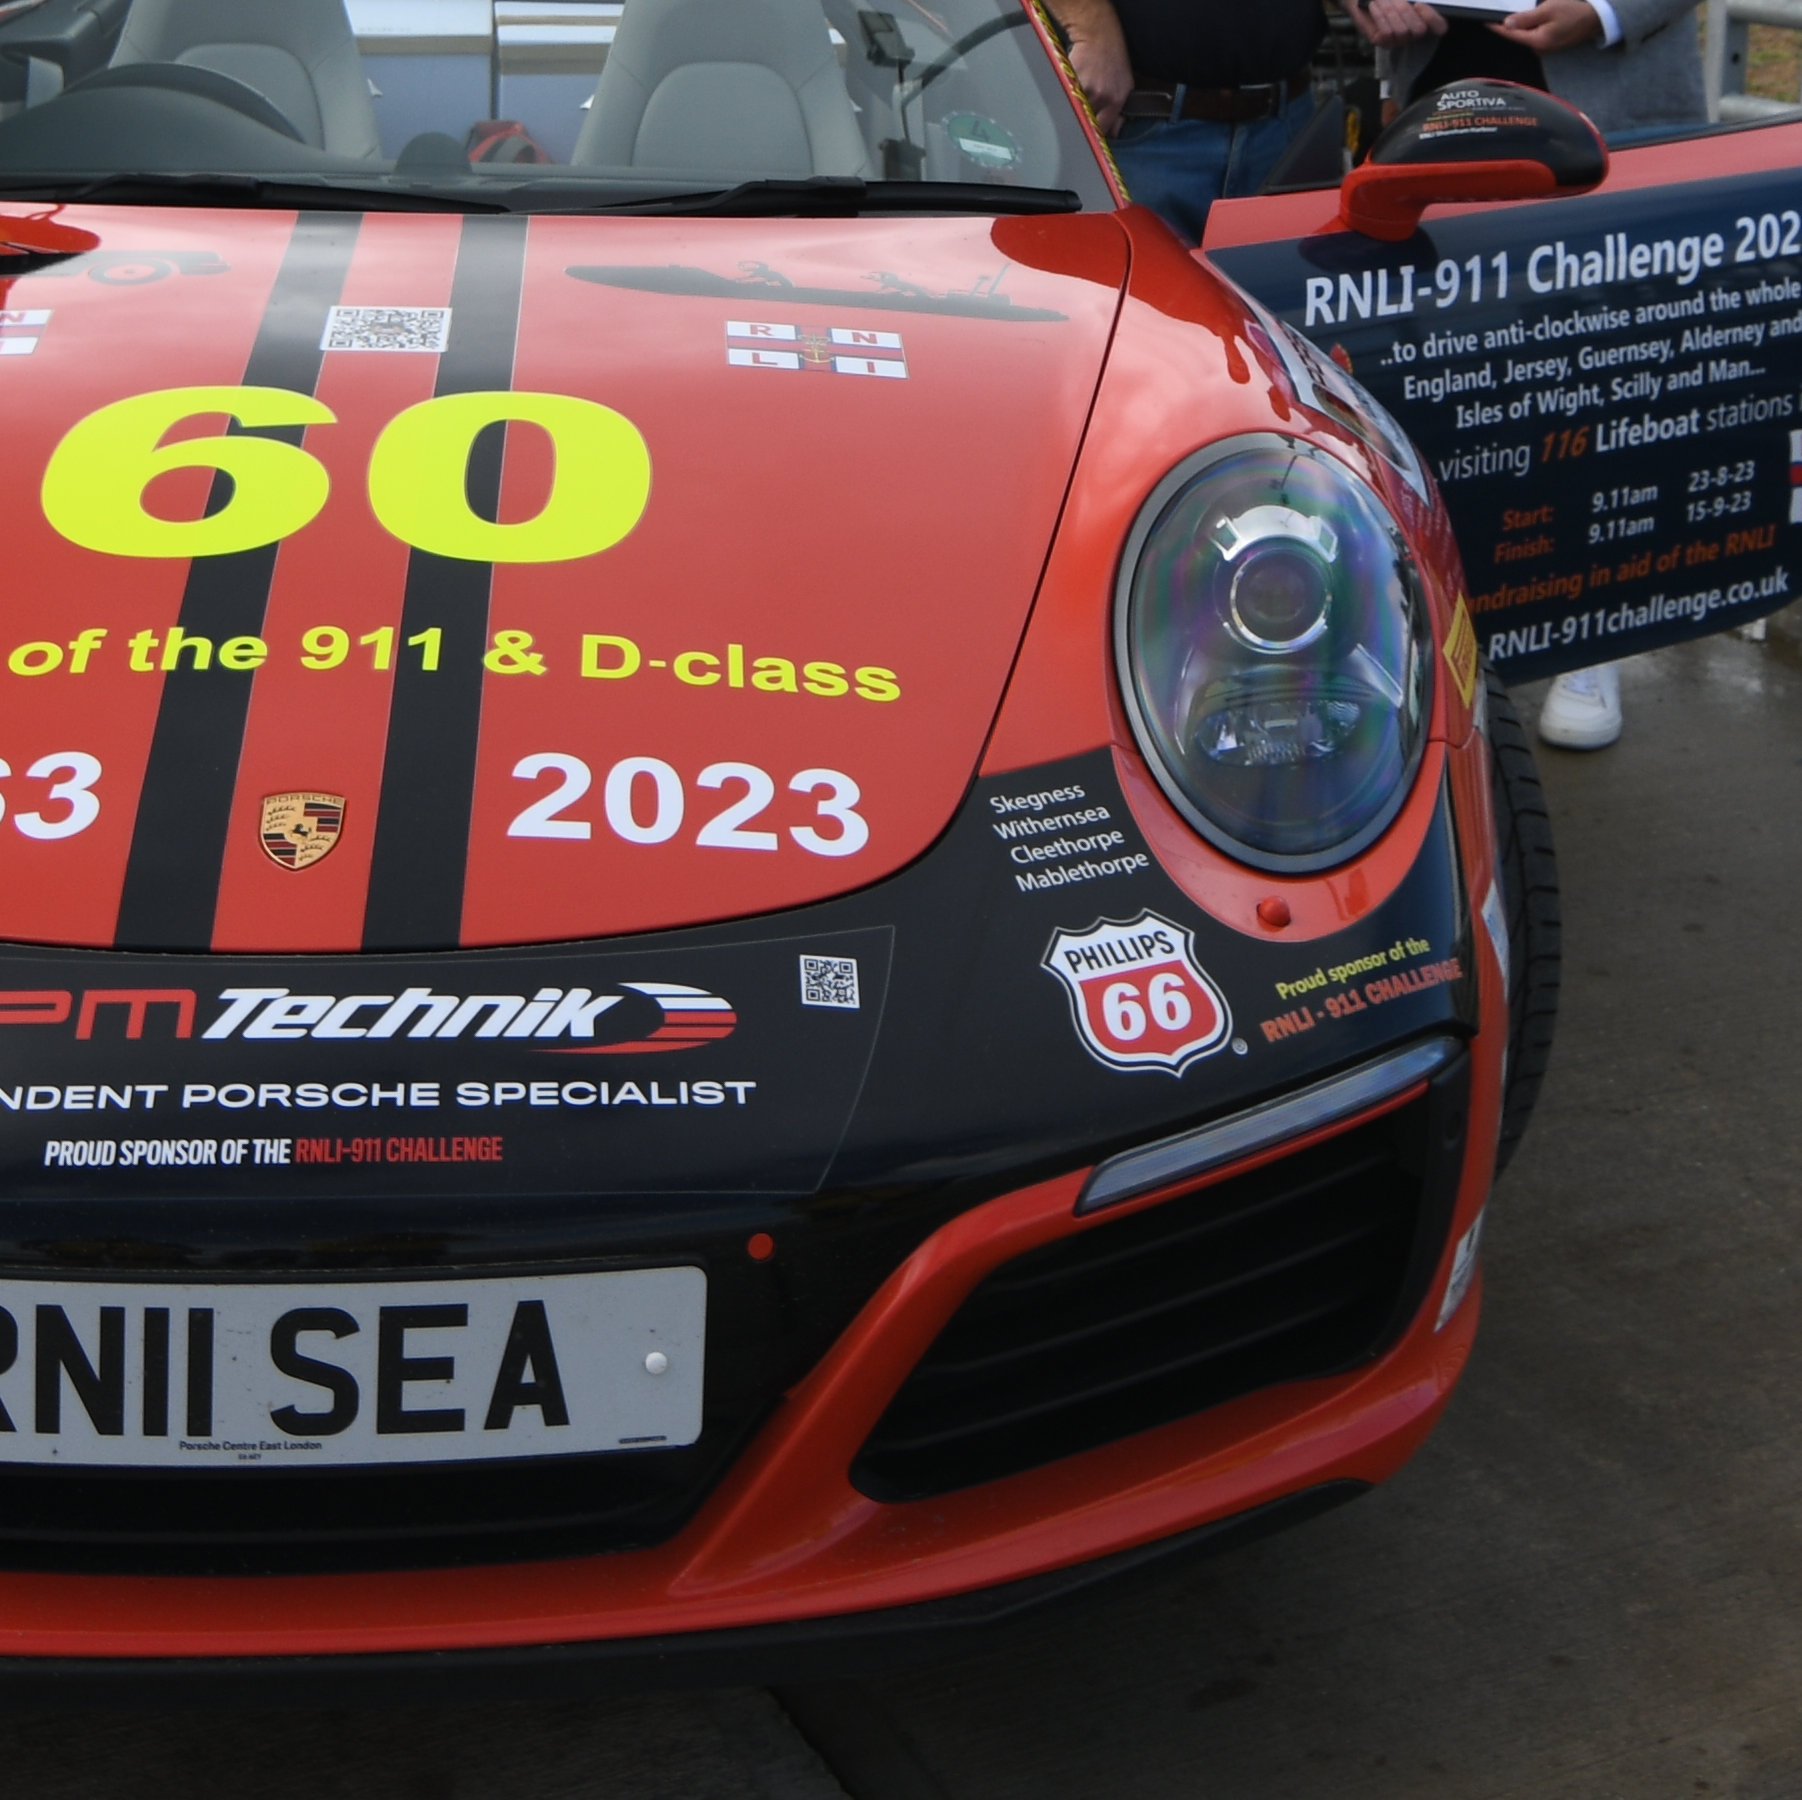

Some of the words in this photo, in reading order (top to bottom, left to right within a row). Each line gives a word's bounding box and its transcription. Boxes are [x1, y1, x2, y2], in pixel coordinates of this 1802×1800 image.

[1436, 97, 1507, 111] SPORTIVA
[1440, 90, 1479, 101] AUTO
[1422, 118, 1472, 132] RNLI-911
[1475, 116, 1538, 127] CHALLENGE
[1305, 251, 1509, 327] RNLI-911
[1527, 232, 1724, 294] Challenge
[1423, 332, 1478, 359] drive
[1484, 305, 1630, 348] anti-clockwise
[1636, 293, 1705, 325] around
[1710, 287, 1741, 313] the
[1746, 277, 1802, 306] whole
[1404, 362, 1497, 403] England,
[1503, 355, 1572, 385] Jersey,
[1578, 339, 1675, 371] Guernsey,
[1680, 321, 1766, 353] Alderney
[1456, 401, 1503, 429] Isles
[1509, 393, 1531, 419] of
[1536, 384, 1604, 416] Wight,
[1611, 372, 1662, 401] Scilly
[1667, 362, 1703, 391] and
[1708, 359, 1767, 383] Man...
[1541, 427, 1589, 463] 116
[1596, 409, 1701, 452] Lifeboat
[1706, 393, 1794, 431] stations
[40, 384, 652, 563] 60
[1592, 485, 1658, 513] 9.11am
[1688, 460, 1755, 492] 23-8-23
[1502, 506, 1554, 532] Start:
[1588, 515, 1655, 544] 9.11am
[1686, 491, 1752, 522] 15-9-23
[1495, 536, 1555, 563] Finish:
[1590, 563, 1611, 588] in
[1617, 557, 1651, 581] aid
[1656, 545, 1683, 572] of
[1686, 539, 1720, 566] the
[1725, 524, 1777, 557] RNLI
[7, 627, 111, 676] of
[127, 624, 267, 673] the
[299, 624, 445, 672] 911
[481, 628, 549, 677] &
[581, 632, 902, 703] D-class
[507, 750, 871, 858] 2023
[990, 782, 1086, 815] Skegness
[993, 803, 1111, 841] Withernsea
[1010, 828, 1125, 866] Cleethorpe
[1015, 849, 1150, 894] Mablethorpe
[1064, 930, 1176, 975] PHILLIPS
[1275, 967, 1327, 999] Proud
[1328, 951, 1388, 986] sponsor
[1390, 938, 1409, 967] of
[1403, 935, 1430, 960] the
[202, 986, 621, 1041] Technik
[1102, 972, 1192, 1042] 66
[1261, 1010, 1315, 1044] RNLI
[1326, 989, 1366, 1021] 911
[1367, 957, 1464, 1006] CHALLENGE
[182, 1081, 442, 1108] PORSCHE
[455, 1080, 757, 1107] SPECIALIST
[45, 1140, 115, 1167] PROUD
[118, 1139, 216, 1166] SPONSOR
[220, 1138, 249, 1165] OF
[251, 1137, 292, 1164] THE
[295, 1137, 383, 1163] RNLI-911
[385, 1135, 503, 1162] CHALLENGE
[269, 1298, 571, 1438] SEA
[179, 1440, 221, 1451] Porsche
[223, 1440, 257, 1451] Centre
[259, 1440, 282, 1451] East
[284, 1440, 323, 1450] London
